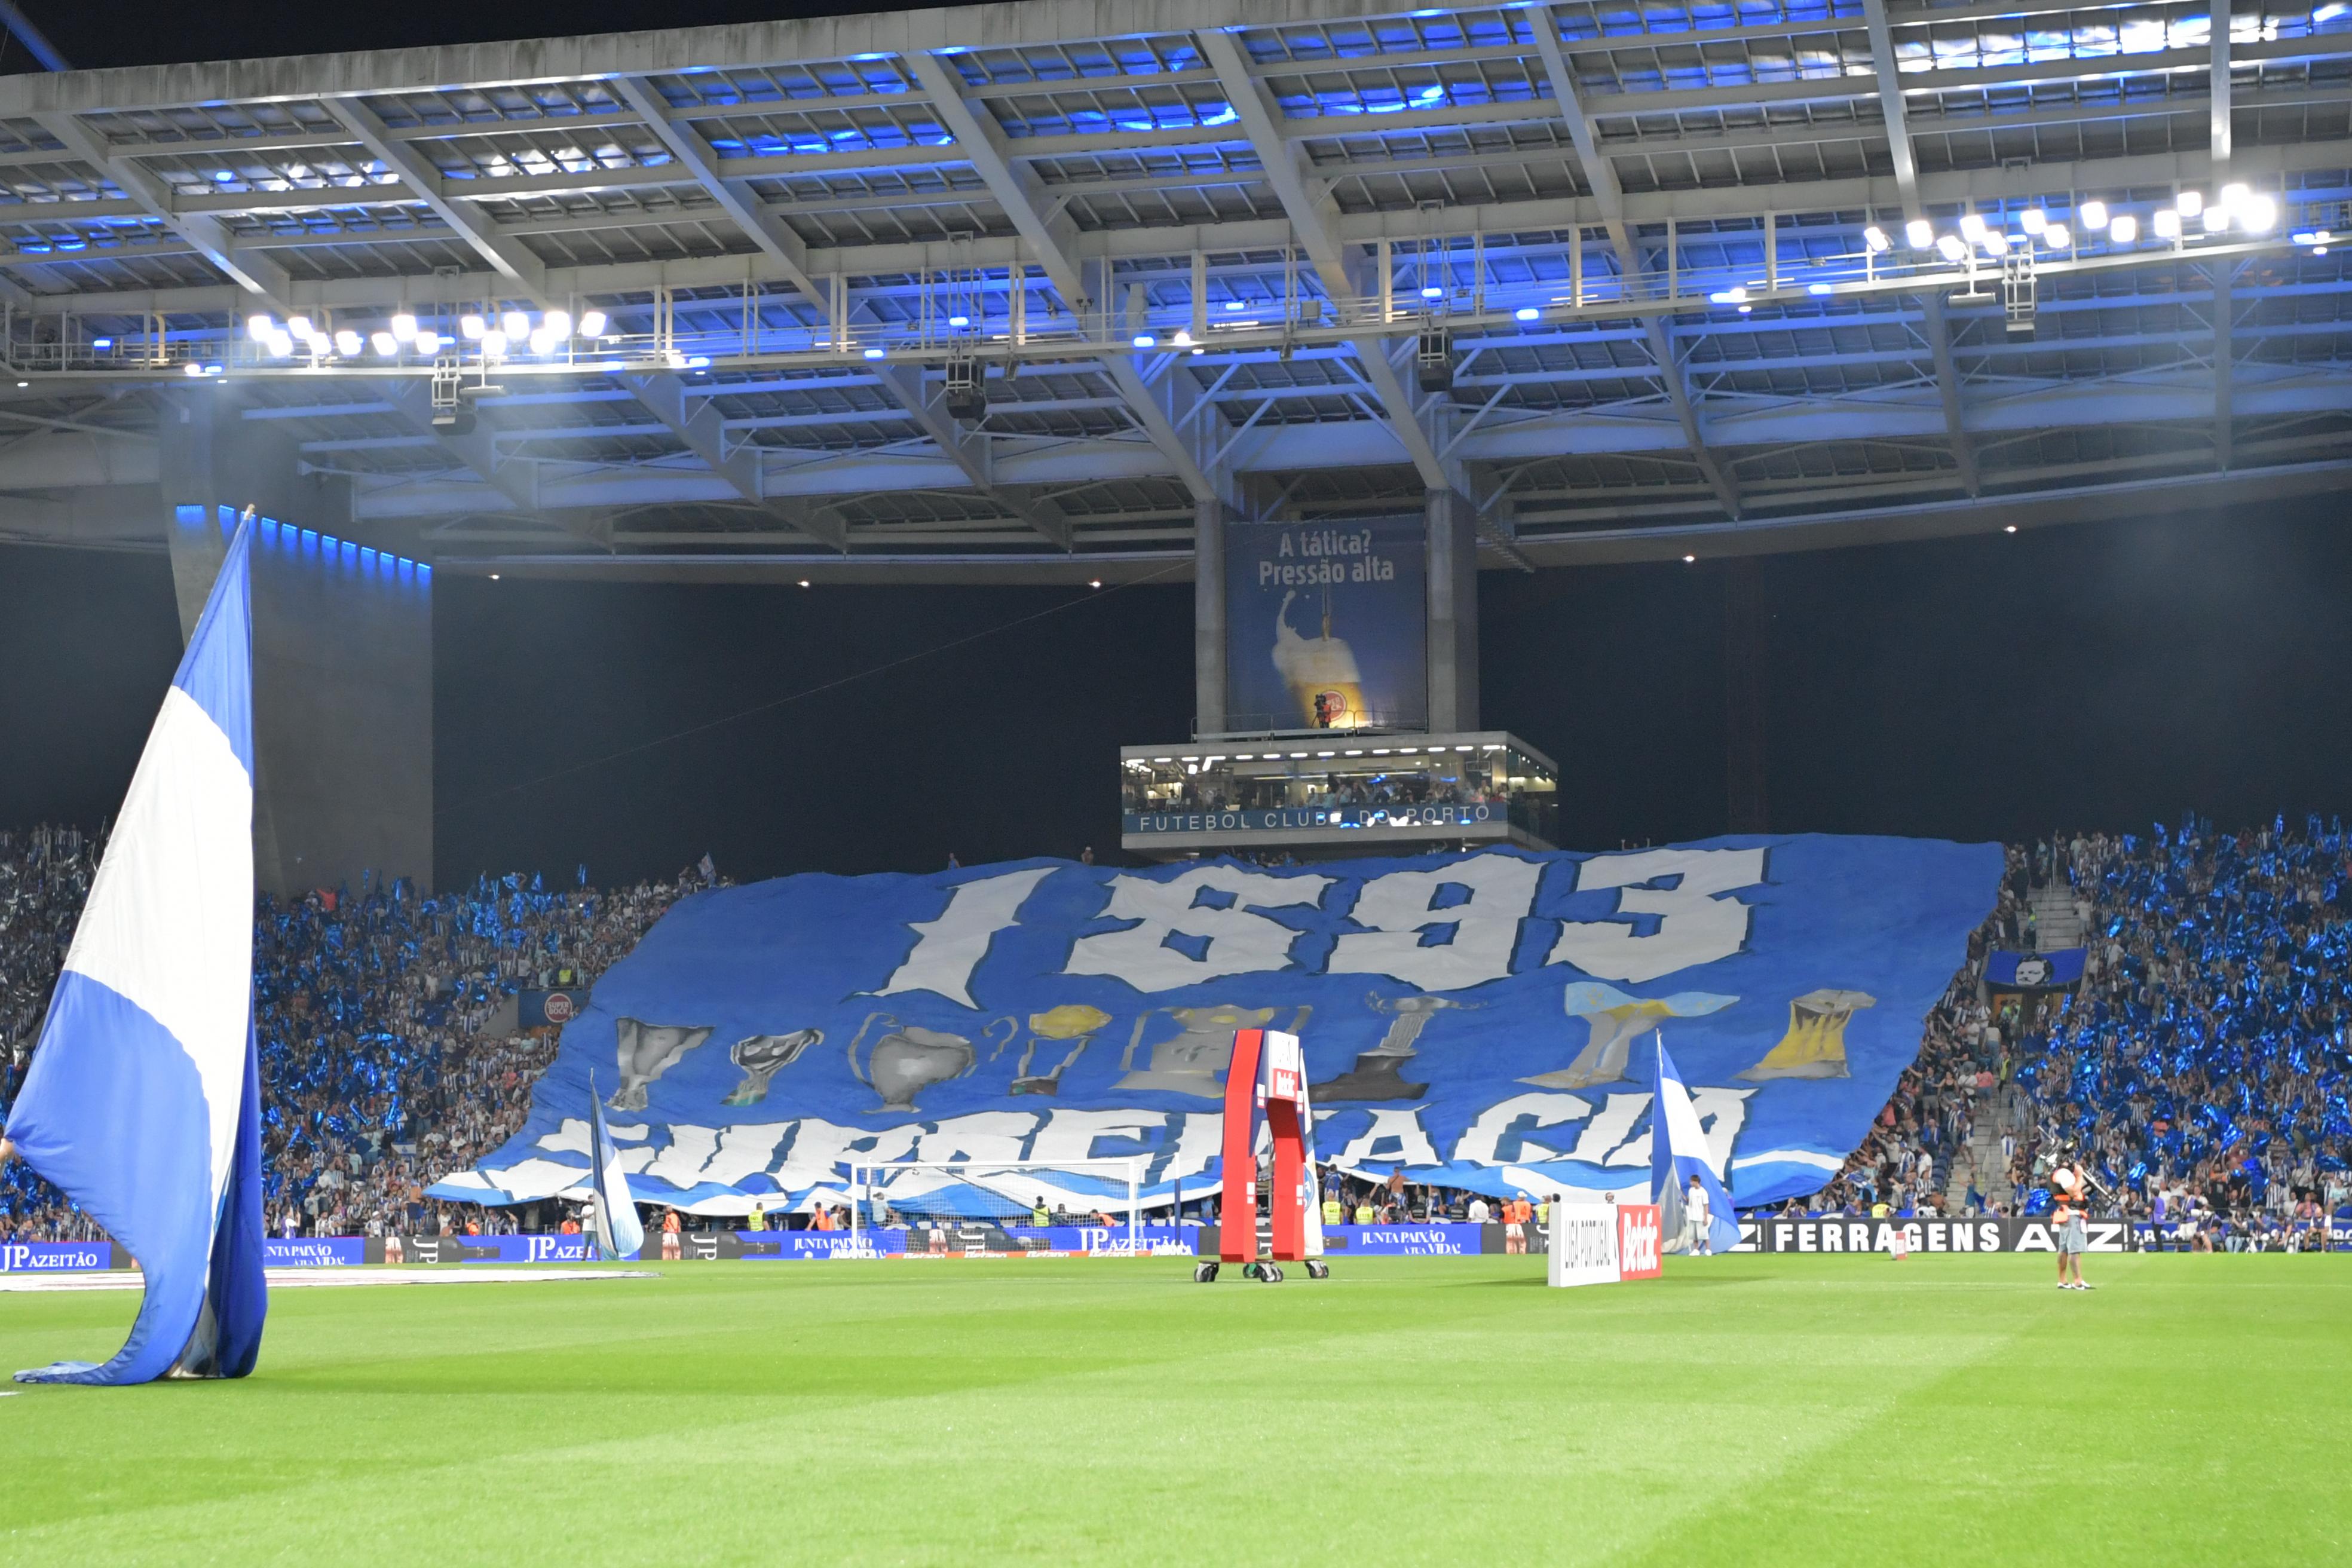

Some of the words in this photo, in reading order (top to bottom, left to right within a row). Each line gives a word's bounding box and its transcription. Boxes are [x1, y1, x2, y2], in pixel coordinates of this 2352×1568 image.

[1279, 532, 1294, 558] A
[1300, 529, 1371, 557] tática?
[1259, 559, 1345, 586] Pressão
[1352, 556, 1394, 582] alta
[1140, 814, 1251, 831] FUTEBOL
[1359, 809, 1391, 825] DO
[1406, 806, 1490, 823] PORTO
[855, 846, 1766, 1010] 1893
[292, 1244, 332, 1256] PAIXÃO
[794, 1238, 829, 1251] JUNTA
[1362, 1232, 1399, 1245] JUNTA
[1401, 1229, 1446, 1244] PAIXÃO
[1428, 1244, 1461, 1254] VIDA!
[1565, 1220, 1578, 1269] LIGA
[1581, 1220, 1610, 1267] PORTUGAL
[1622, 1208, 1658, 1272] Betclic
[1775, 1223, 2001, 1252] FERRAGENS
